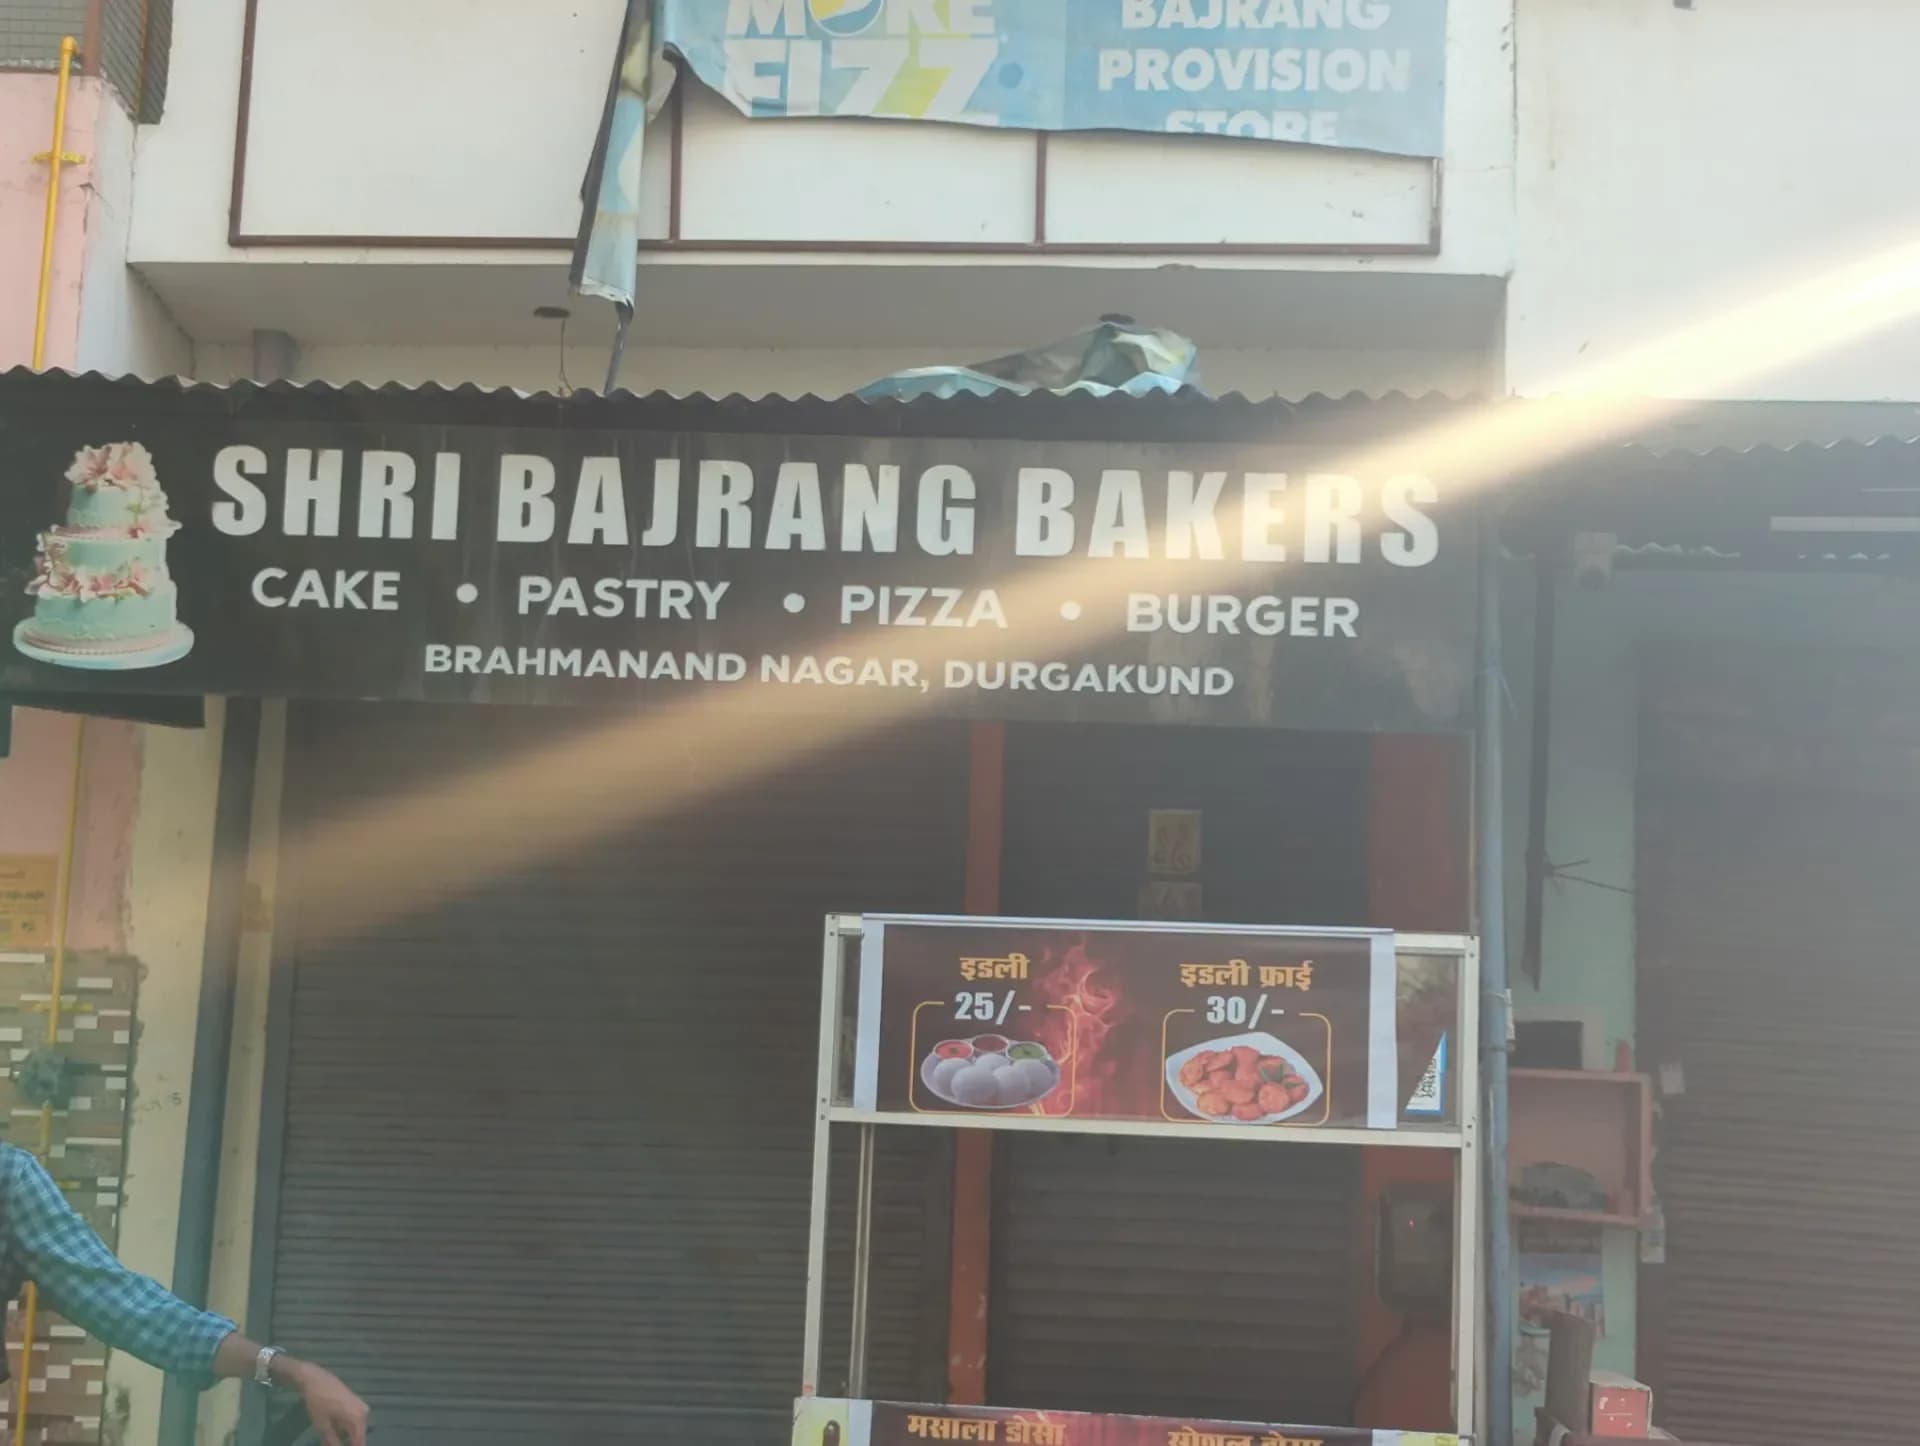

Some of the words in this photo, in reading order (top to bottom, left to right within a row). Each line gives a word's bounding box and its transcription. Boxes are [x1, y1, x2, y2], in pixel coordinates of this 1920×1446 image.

[1121, 0, 1391, 30] BAJRANG
[1097, 47, 1411, 92] PROVISION
[211, 444, 461, 541] SHRI
[496, 453, 977, 557] BAJRANG
[1015, 466, 1439, 567] BAKERS
[251, 567, 400, 611] CAKE
[517, 575, 731, 620] PASTRY
[840, 584, 1009, 629] PIZZA
[1125, 593, 1360, 638] BURGER
[424, 643, 747, 682] BRAHMANAND
[760, 654, 931, 694] NAGAR,
[943, 659, 1235, 697] DURGAKUND
[959, 952, 1031, 981] इडली
[1179, 958, 1252, 988] इडली
[954, 989, 1032, 1026] 25/-
[1206, 993, 1285, 1029] 30/-
[907, 1415, 999, 1442] मसाला
